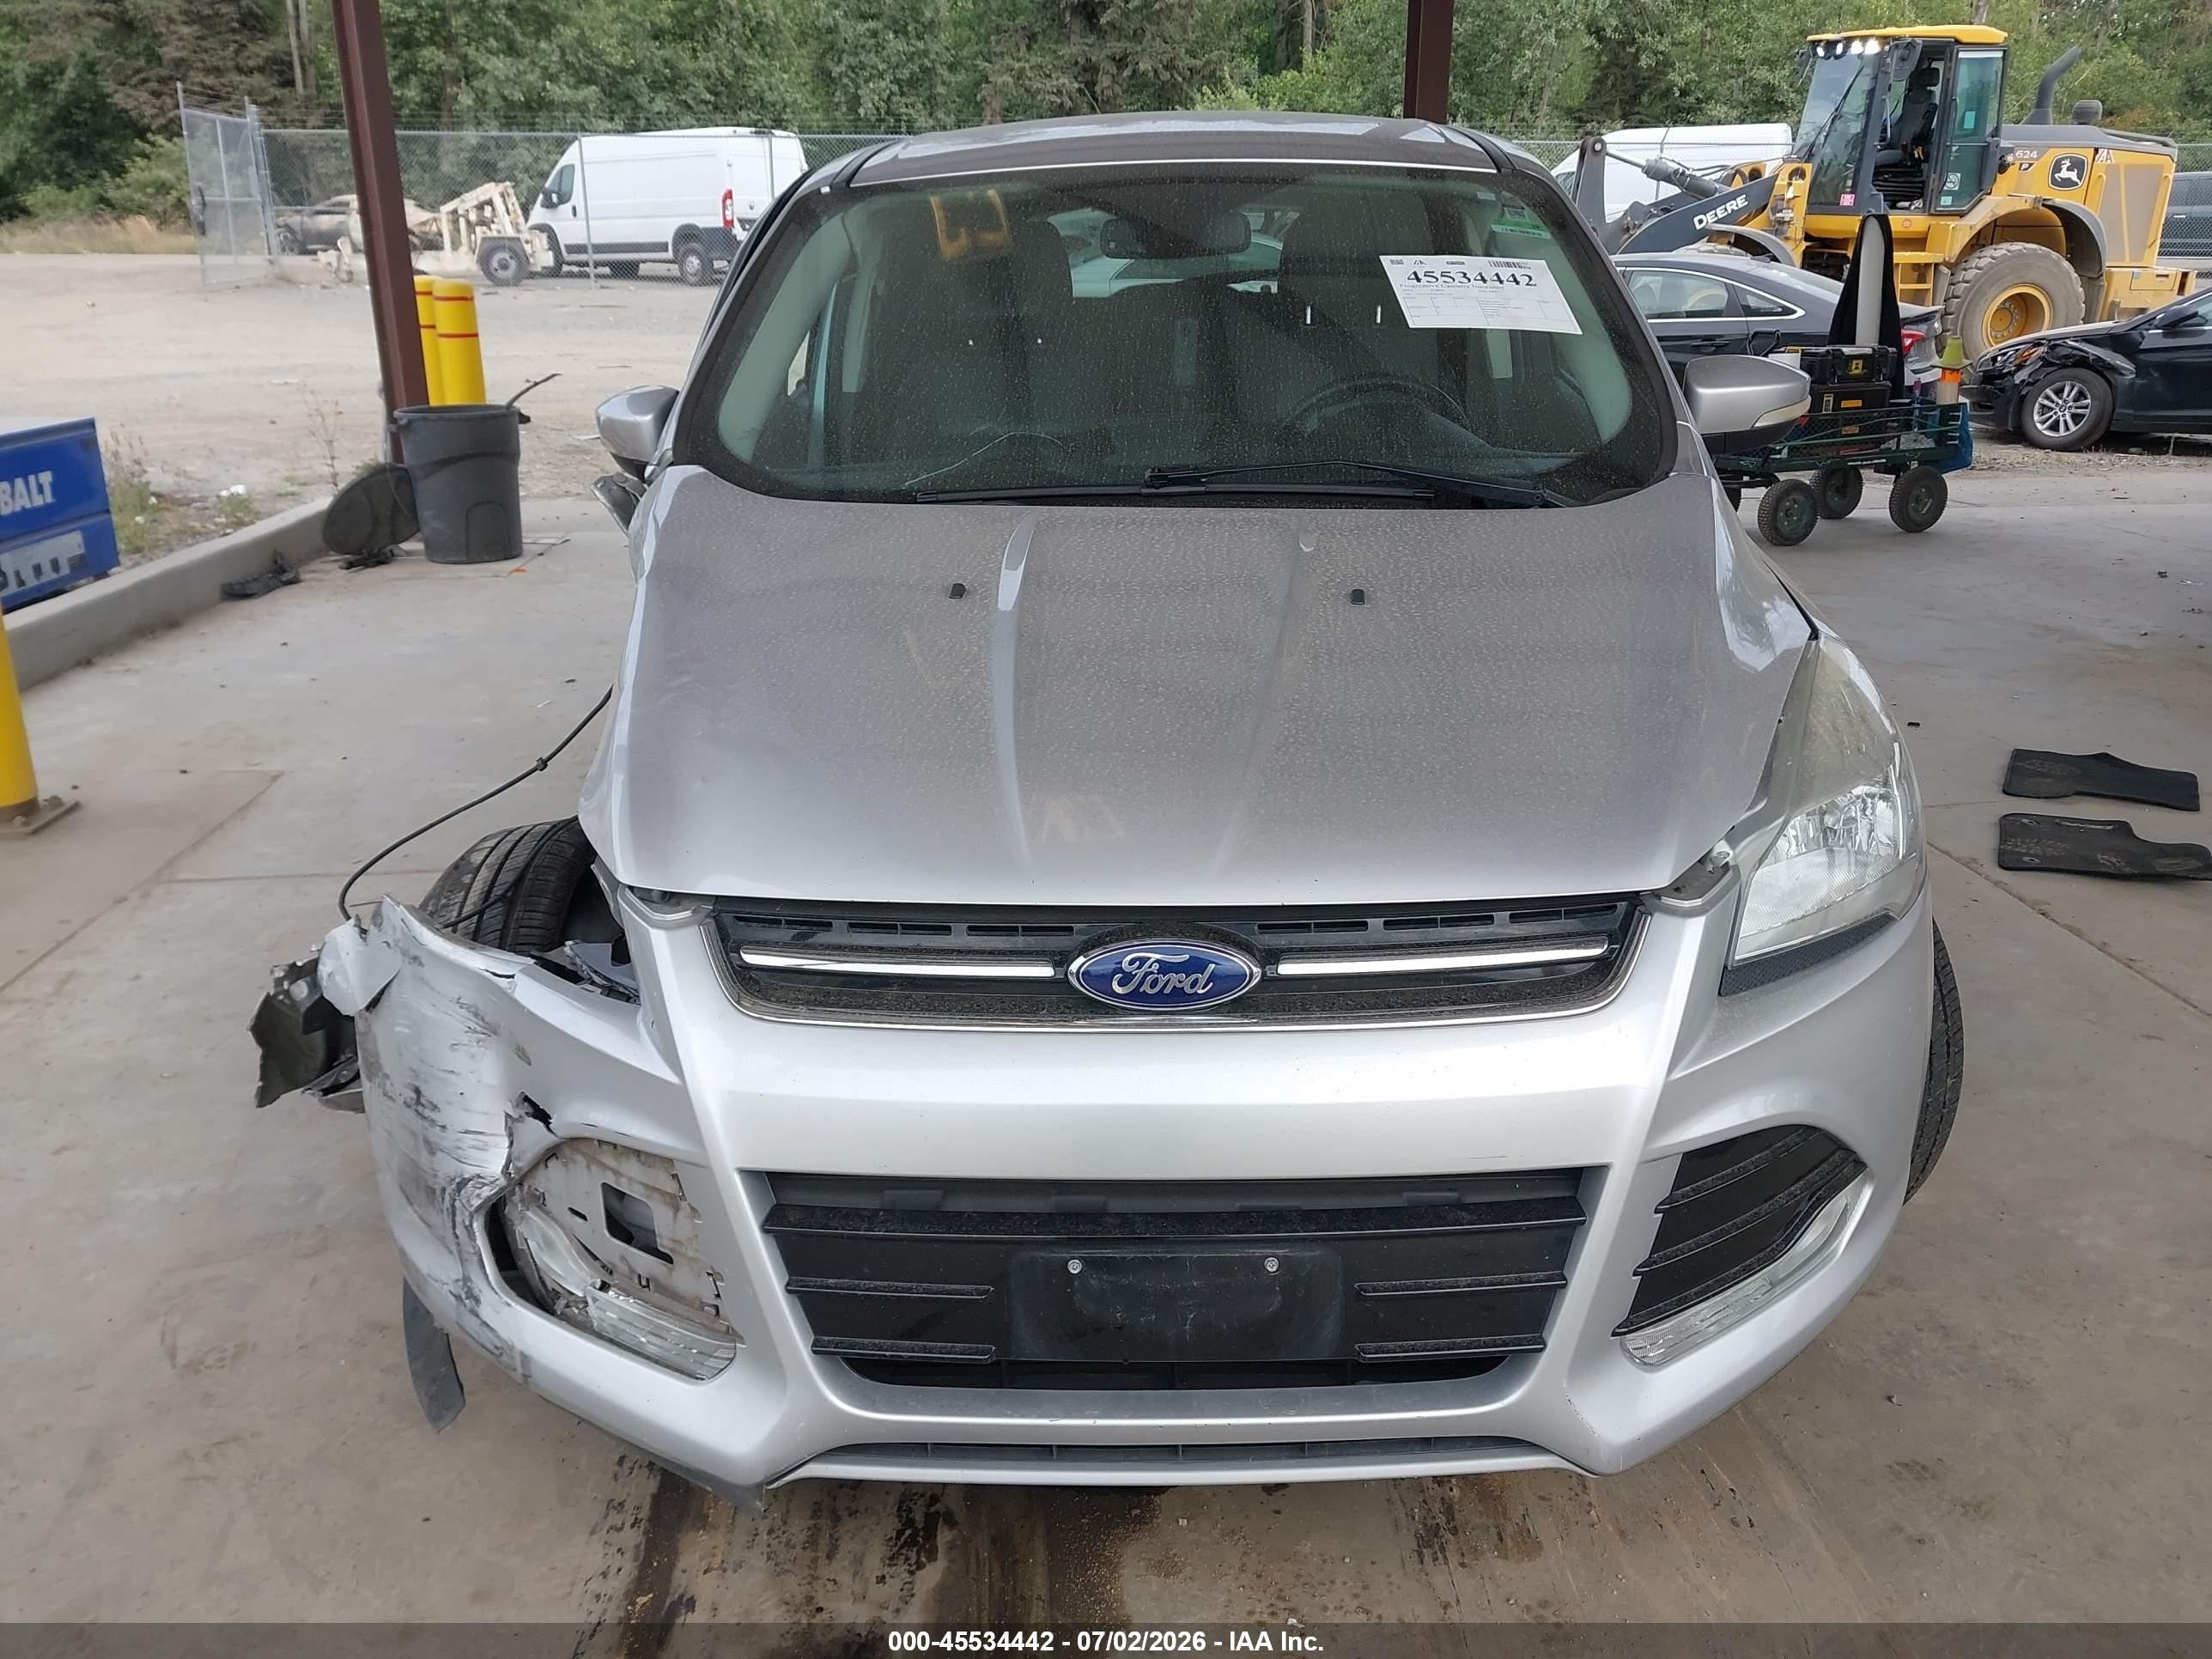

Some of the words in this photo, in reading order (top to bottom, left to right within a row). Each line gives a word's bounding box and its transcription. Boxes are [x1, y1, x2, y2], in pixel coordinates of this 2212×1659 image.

[2015, 149, 2039, 159] 624
[1692, 193, 1749, 231] DEERE
[1407, 270, 1538, 287] 45534442
[1112, 952, 1216, 995] Ford
